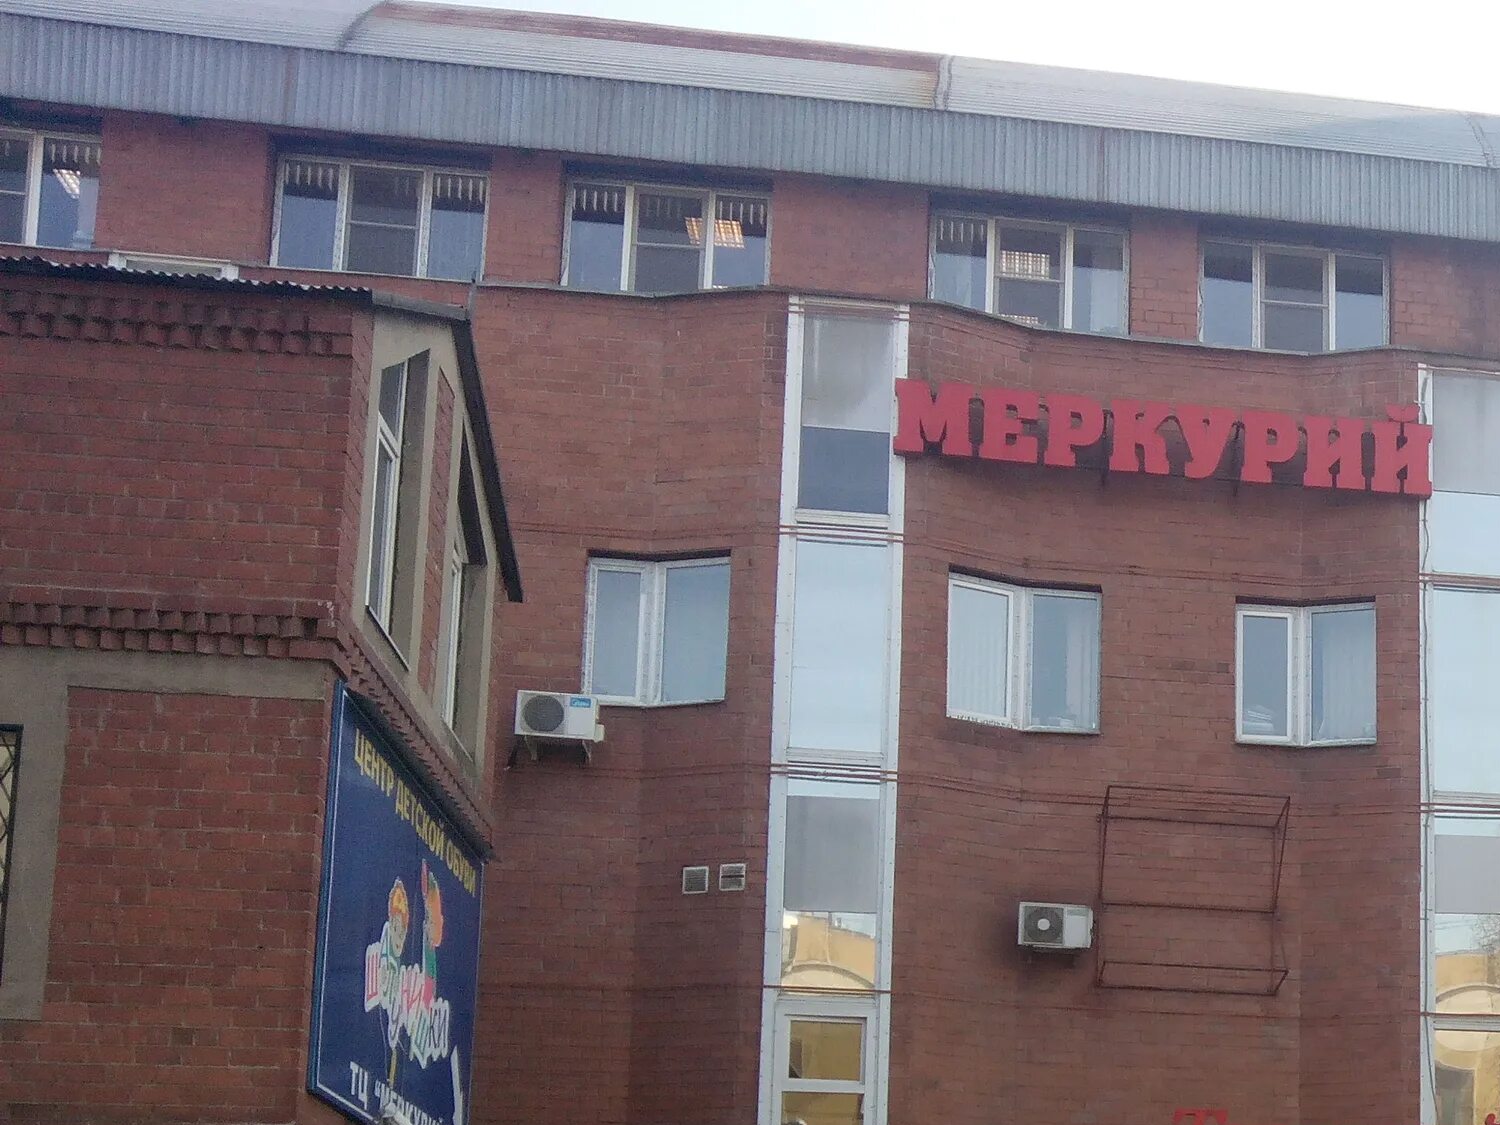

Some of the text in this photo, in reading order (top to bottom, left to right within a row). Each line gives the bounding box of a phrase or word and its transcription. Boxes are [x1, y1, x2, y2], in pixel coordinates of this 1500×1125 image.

[893, 377, 1433, 497] МЕРКУРИЙ
[354, 727, 476, 898] ЦЕНТР ДЕТСКОЙ ОБУВИ
[349, 1061, 368, 1110] ТЦ
